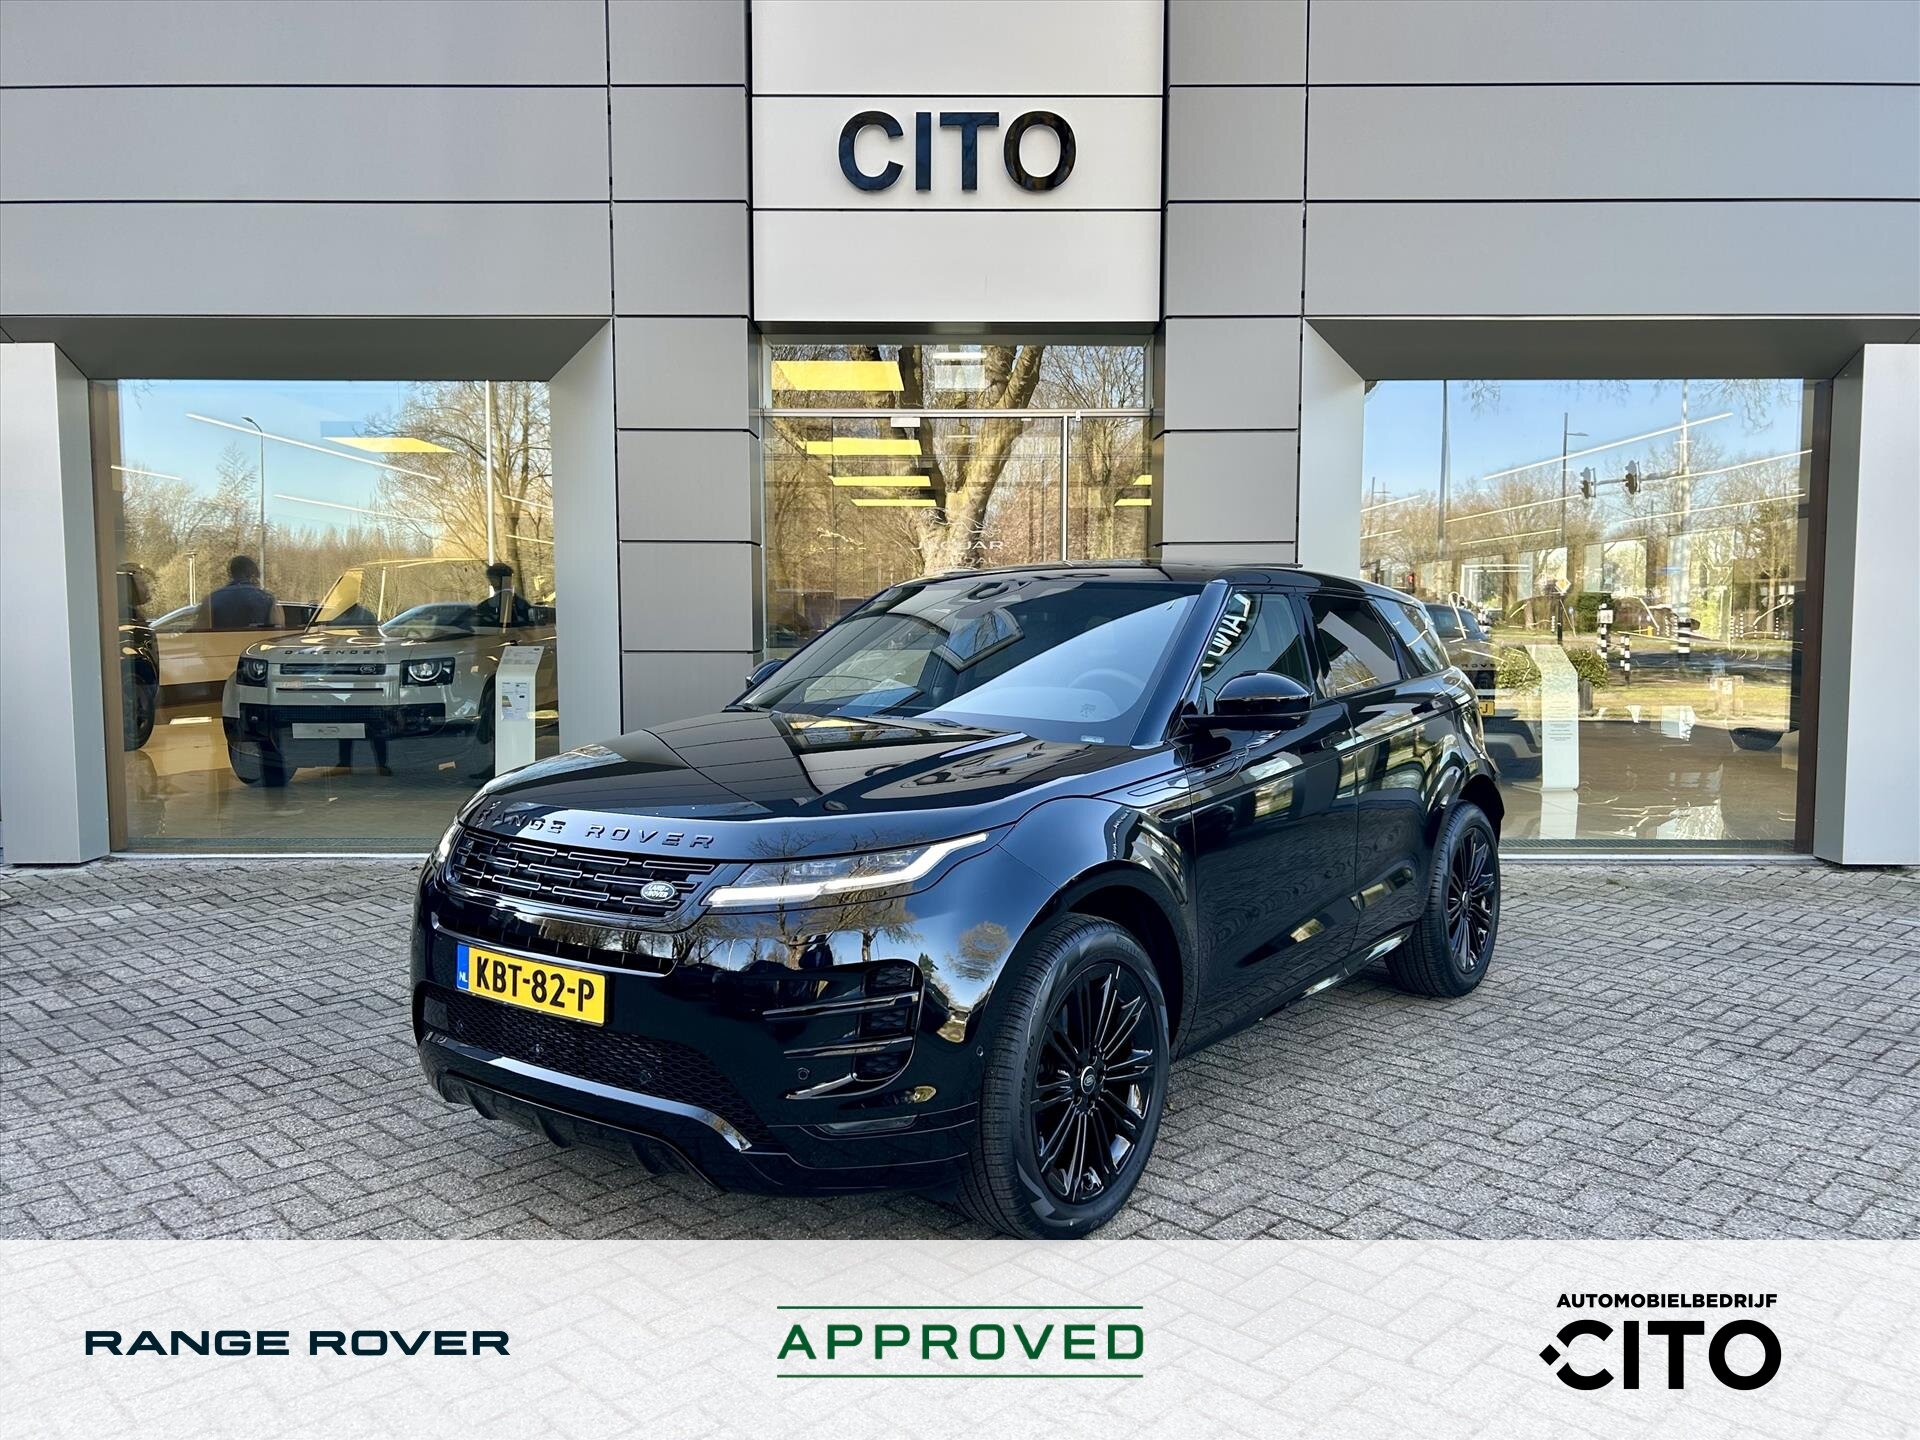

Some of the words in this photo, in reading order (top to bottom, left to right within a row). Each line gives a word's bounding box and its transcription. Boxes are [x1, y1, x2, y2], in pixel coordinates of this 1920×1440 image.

[838, 110, 1077, 193] CITO
[475, 800, 567, 834] RANGE
[584, 823, 715, 849] ROVER
[458, 971, 468, 983] NL
[476, 956, 595, 1012] KBT-82-P
